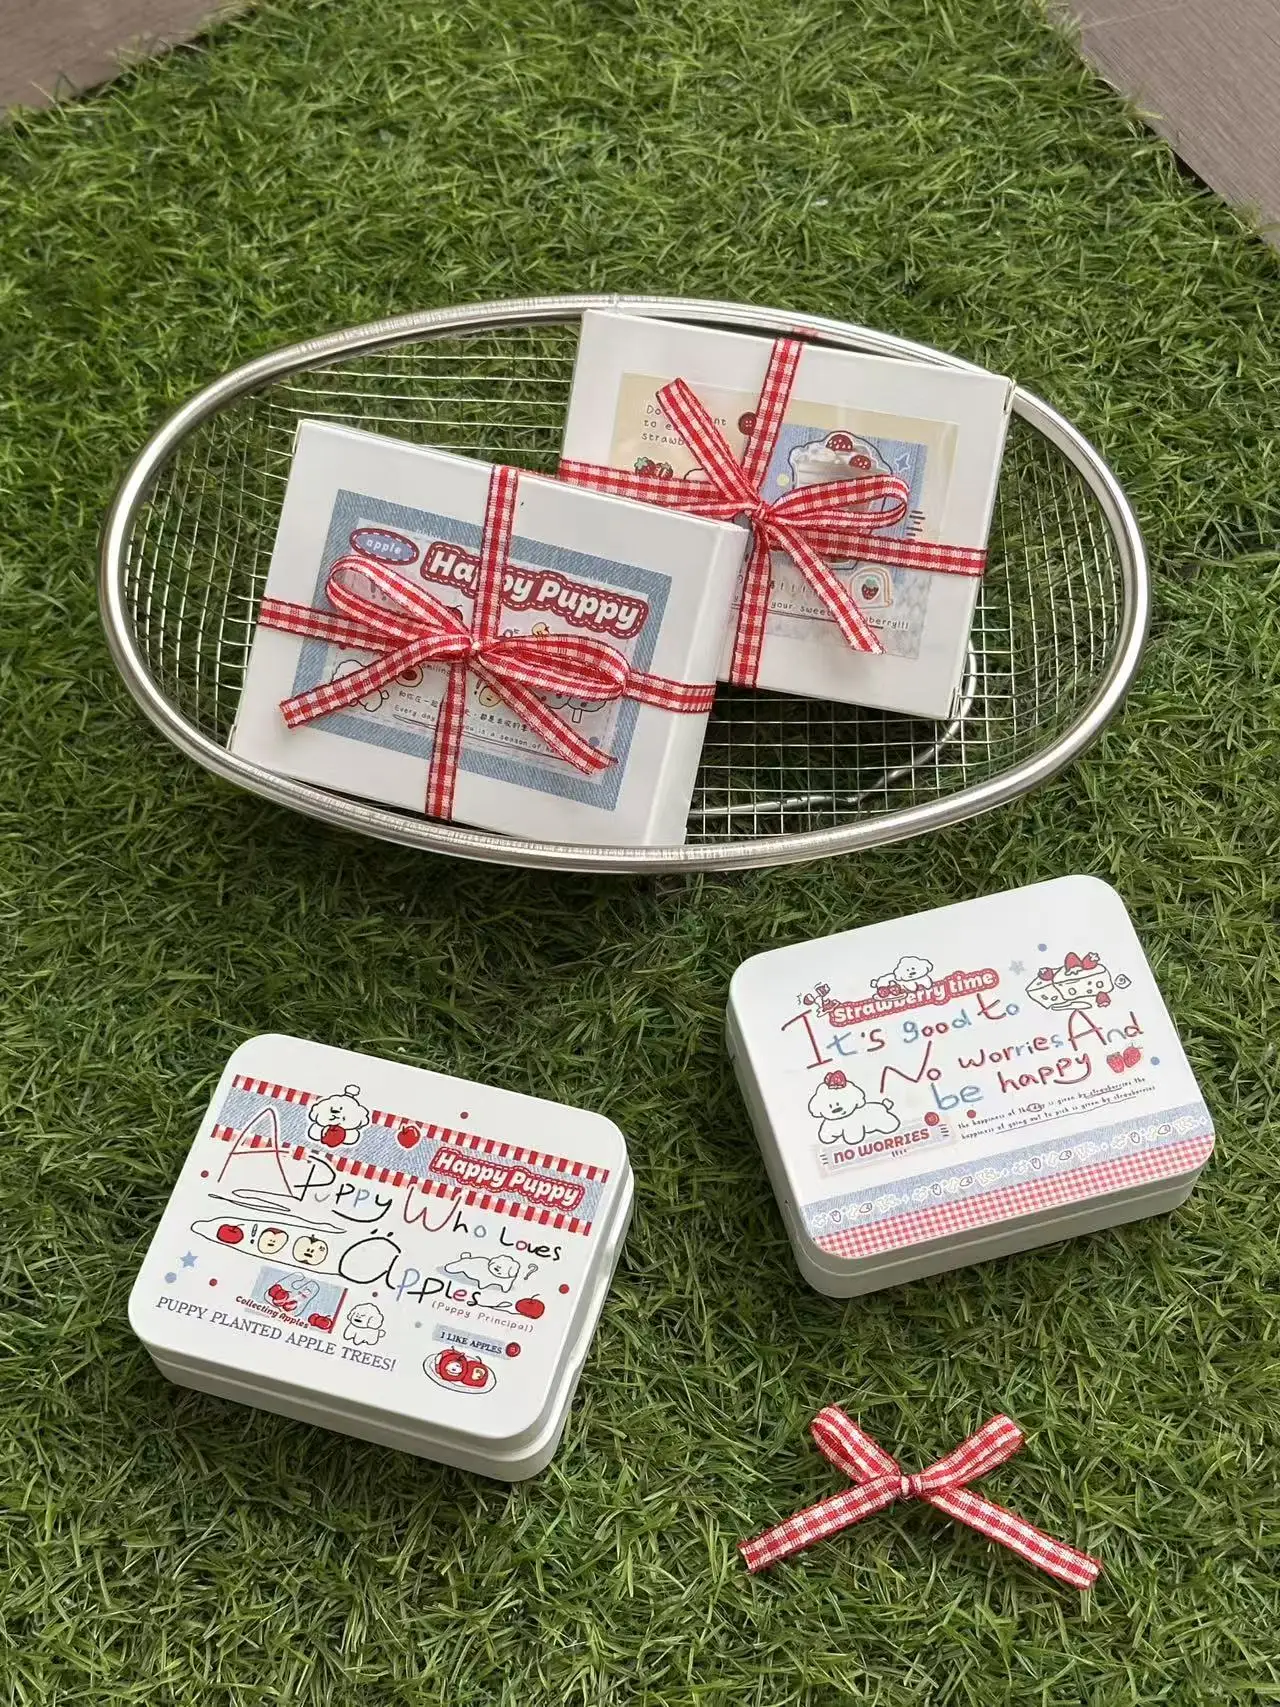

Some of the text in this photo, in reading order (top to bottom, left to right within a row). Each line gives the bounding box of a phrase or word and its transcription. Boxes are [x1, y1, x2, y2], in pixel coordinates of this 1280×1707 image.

[644, 419, 657, 428] to
[366, 536, 402, 555] apple
[537, 579, 640, 631] Puppy
[771, 601, 793, 611] your
[949, 971, 996, 995] time
[781, 993, 1020, 1070] It's good to
[880, 1040, 942, 1094] No
[1067, 1008, 1144, 1052] And
[930, 1052, 1093, 1111] be happy
[857, 1127, 931, 1158] WORRIES
[217, 1107, 301, 1201] A
[403, 1181, 487, 1239] Who
[499, 1226, 562, 1262] Loves
[433, 1150, 580, 1205] Happy Puppy
[155, 1296, 397, 1373] PUPPY PLANTED APPLE TREES!
[431, 1300, 534, 1333] (Puppy Principal)
[440, 1331, 503, 1354] I LIKE APPLES
